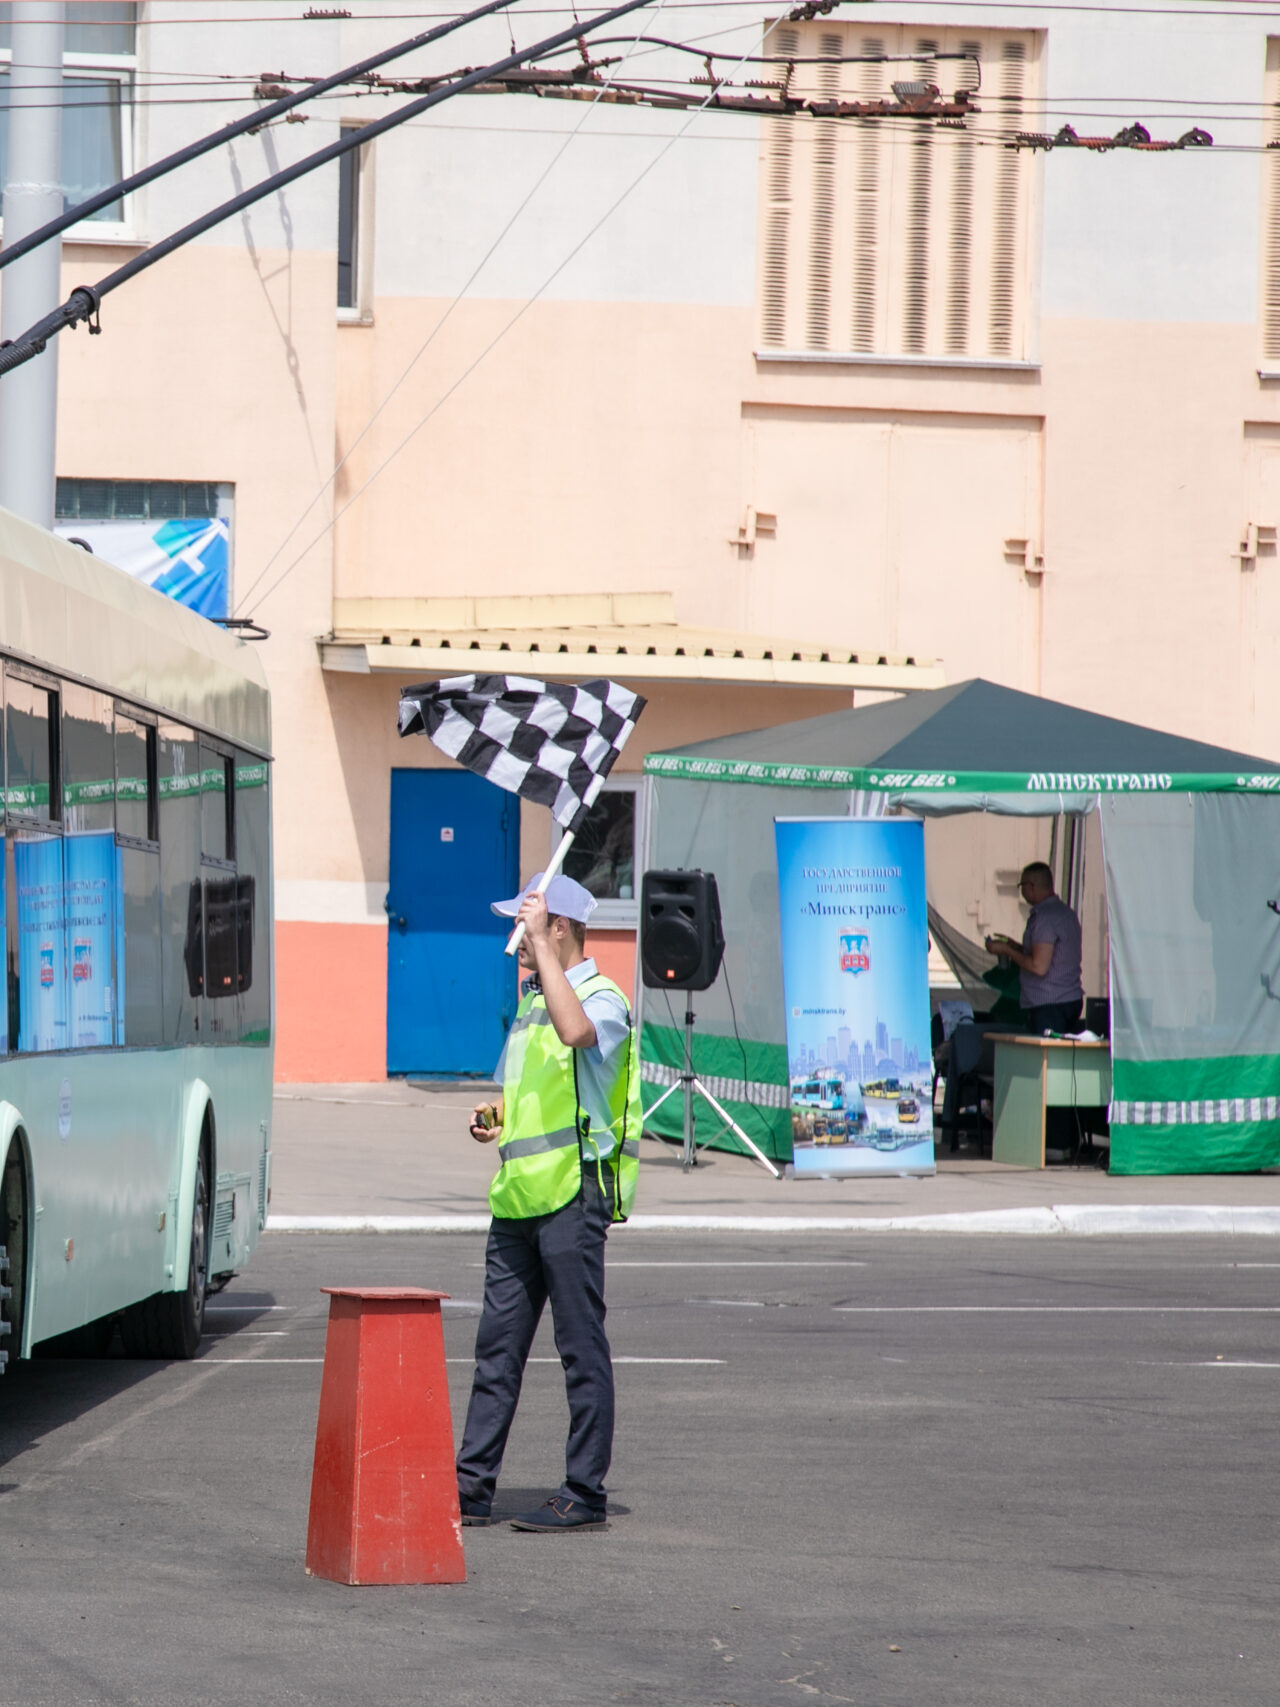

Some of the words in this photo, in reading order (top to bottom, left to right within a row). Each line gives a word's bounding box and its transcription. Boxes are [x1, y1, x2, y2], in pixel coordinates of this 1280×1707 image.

[878, 774, 914, 788] SKI
[911, 774, 946, 787] BEL
[1246, 775, 1280, 789] SKI
[802, 867, 901, 880] ГОСУДАРСТВЕННОЕ
[817, 883, 887, 894] ПРЕДПРИЯТИЕ
[800, 901, 906, 919] «Минсктранс»
